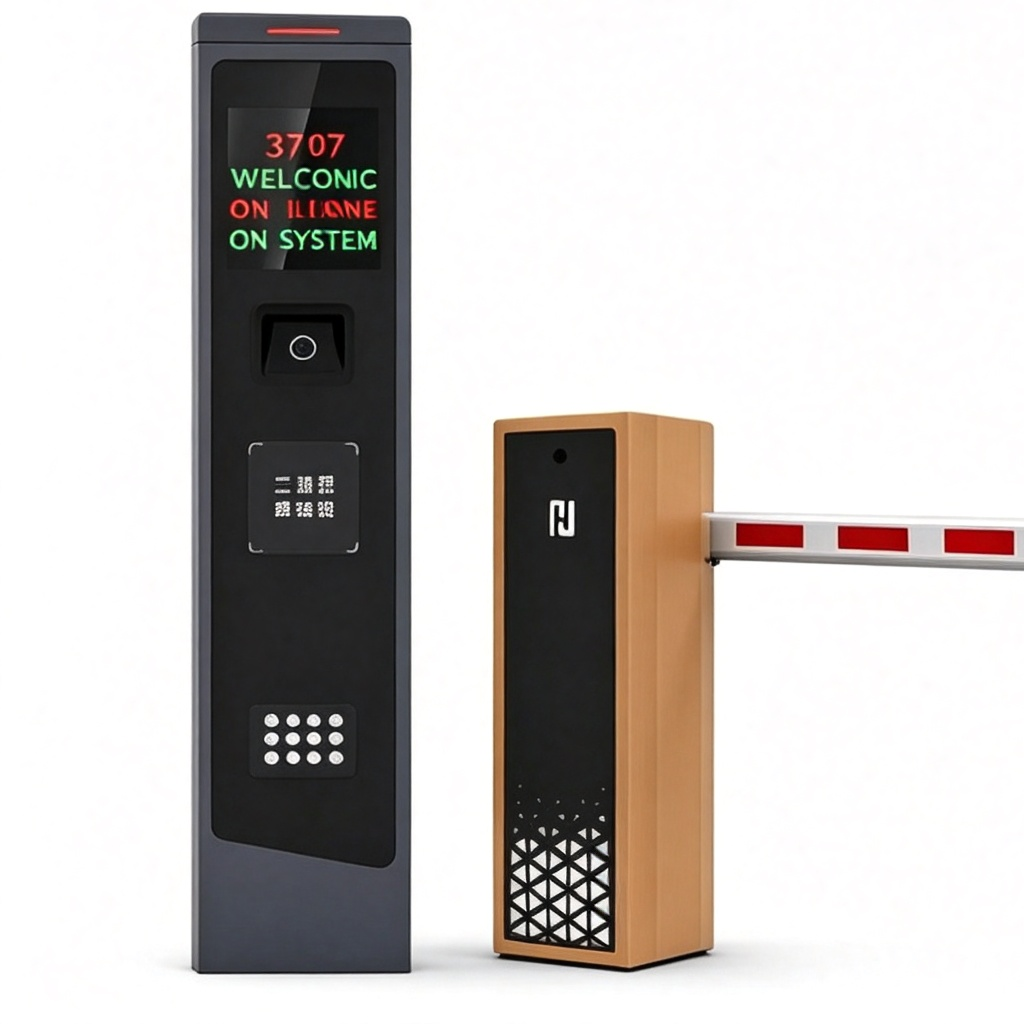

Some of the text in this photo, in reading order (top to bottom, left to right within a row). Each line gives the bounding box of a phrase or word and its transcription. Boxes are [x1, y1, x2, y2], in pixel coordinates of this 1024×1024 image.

[265, 132, 346, 160] 3707
[230, 167, 378, 190] WELCONIC
[229, 198, 269, 220] ON
[229, 229, 378, 251] ON SYSTEM
